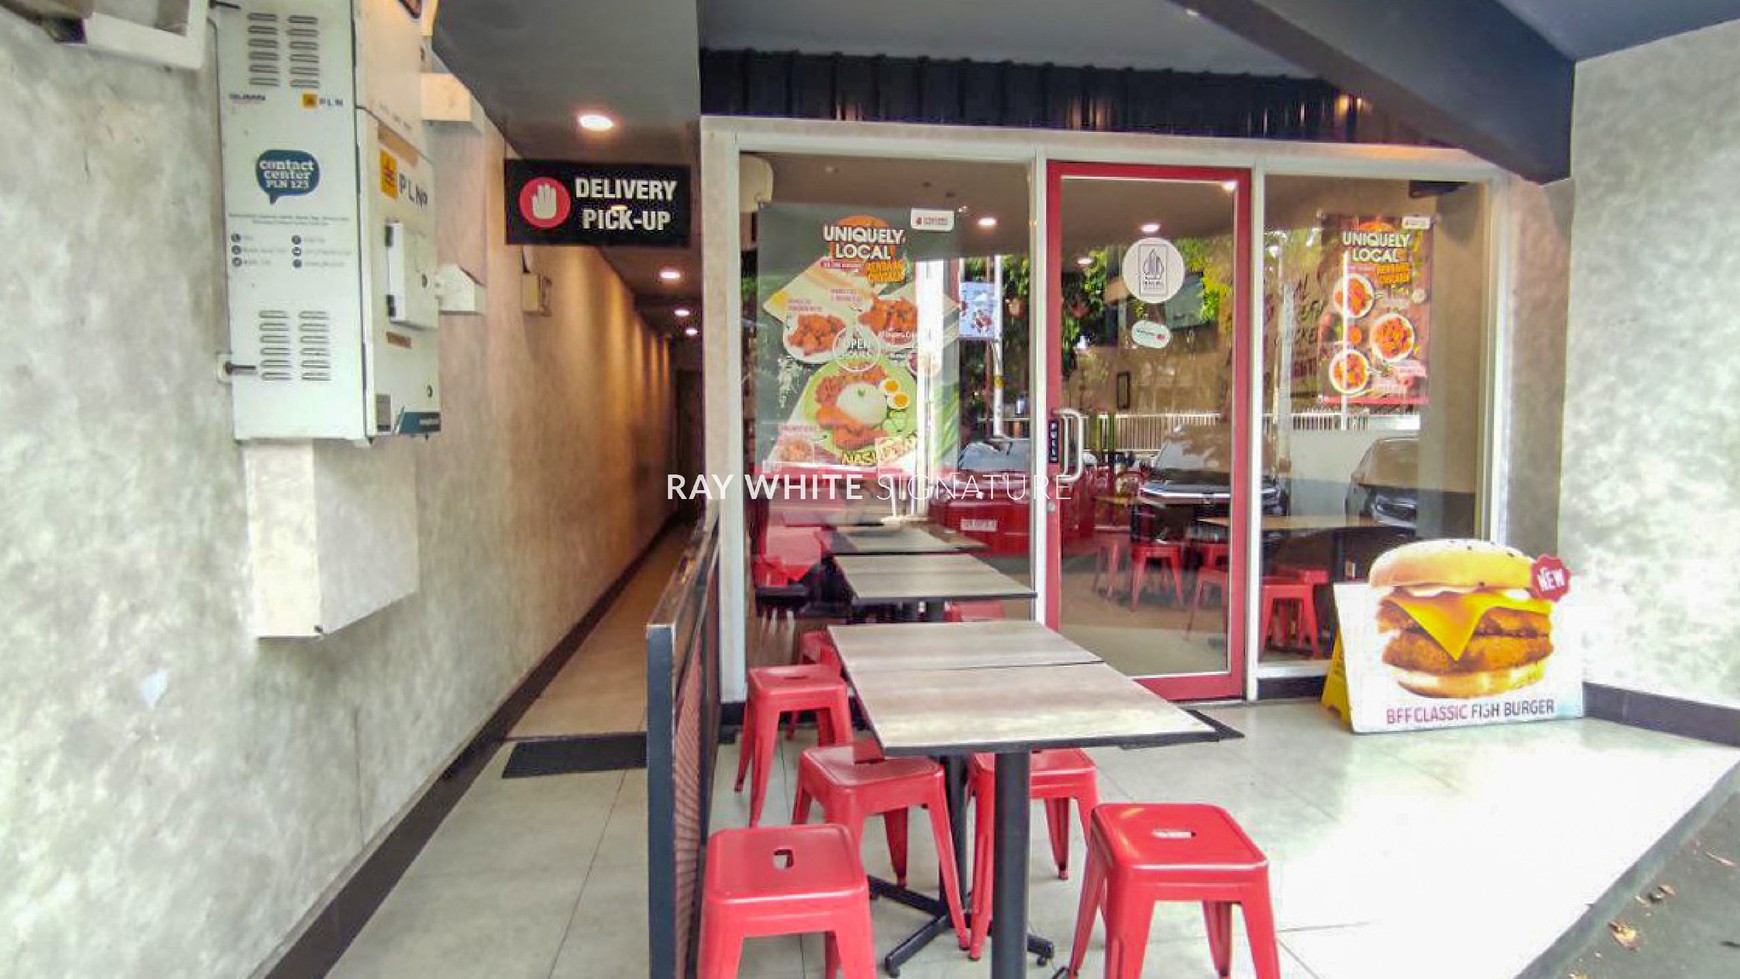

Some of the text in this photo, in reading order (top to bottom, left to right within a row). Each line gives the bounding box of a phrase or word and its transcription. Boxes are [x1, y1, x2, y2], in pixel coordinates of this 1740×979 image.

[319, 98, 344, 107] PLN
[259, 159, 315, 172] contact
[263, 170, 312, 180] center
[265, 180, 288, 189] PLN
[575, 177, 678, 201] DELIVERY
[582, 208, 672, 231] PICK-UP
[823, 224, 904, 245] UNIQUELY
[1342, 231, 1411, 248] UNIQUELY
[835, 243, 892, 260] LOCAL
[1352, 248, 1400, 263] LOCAL
[1537, 567, 1565, 591] NEW
[1386, 699, 1555, 724] BFF CLASSIC FISH BURGER
